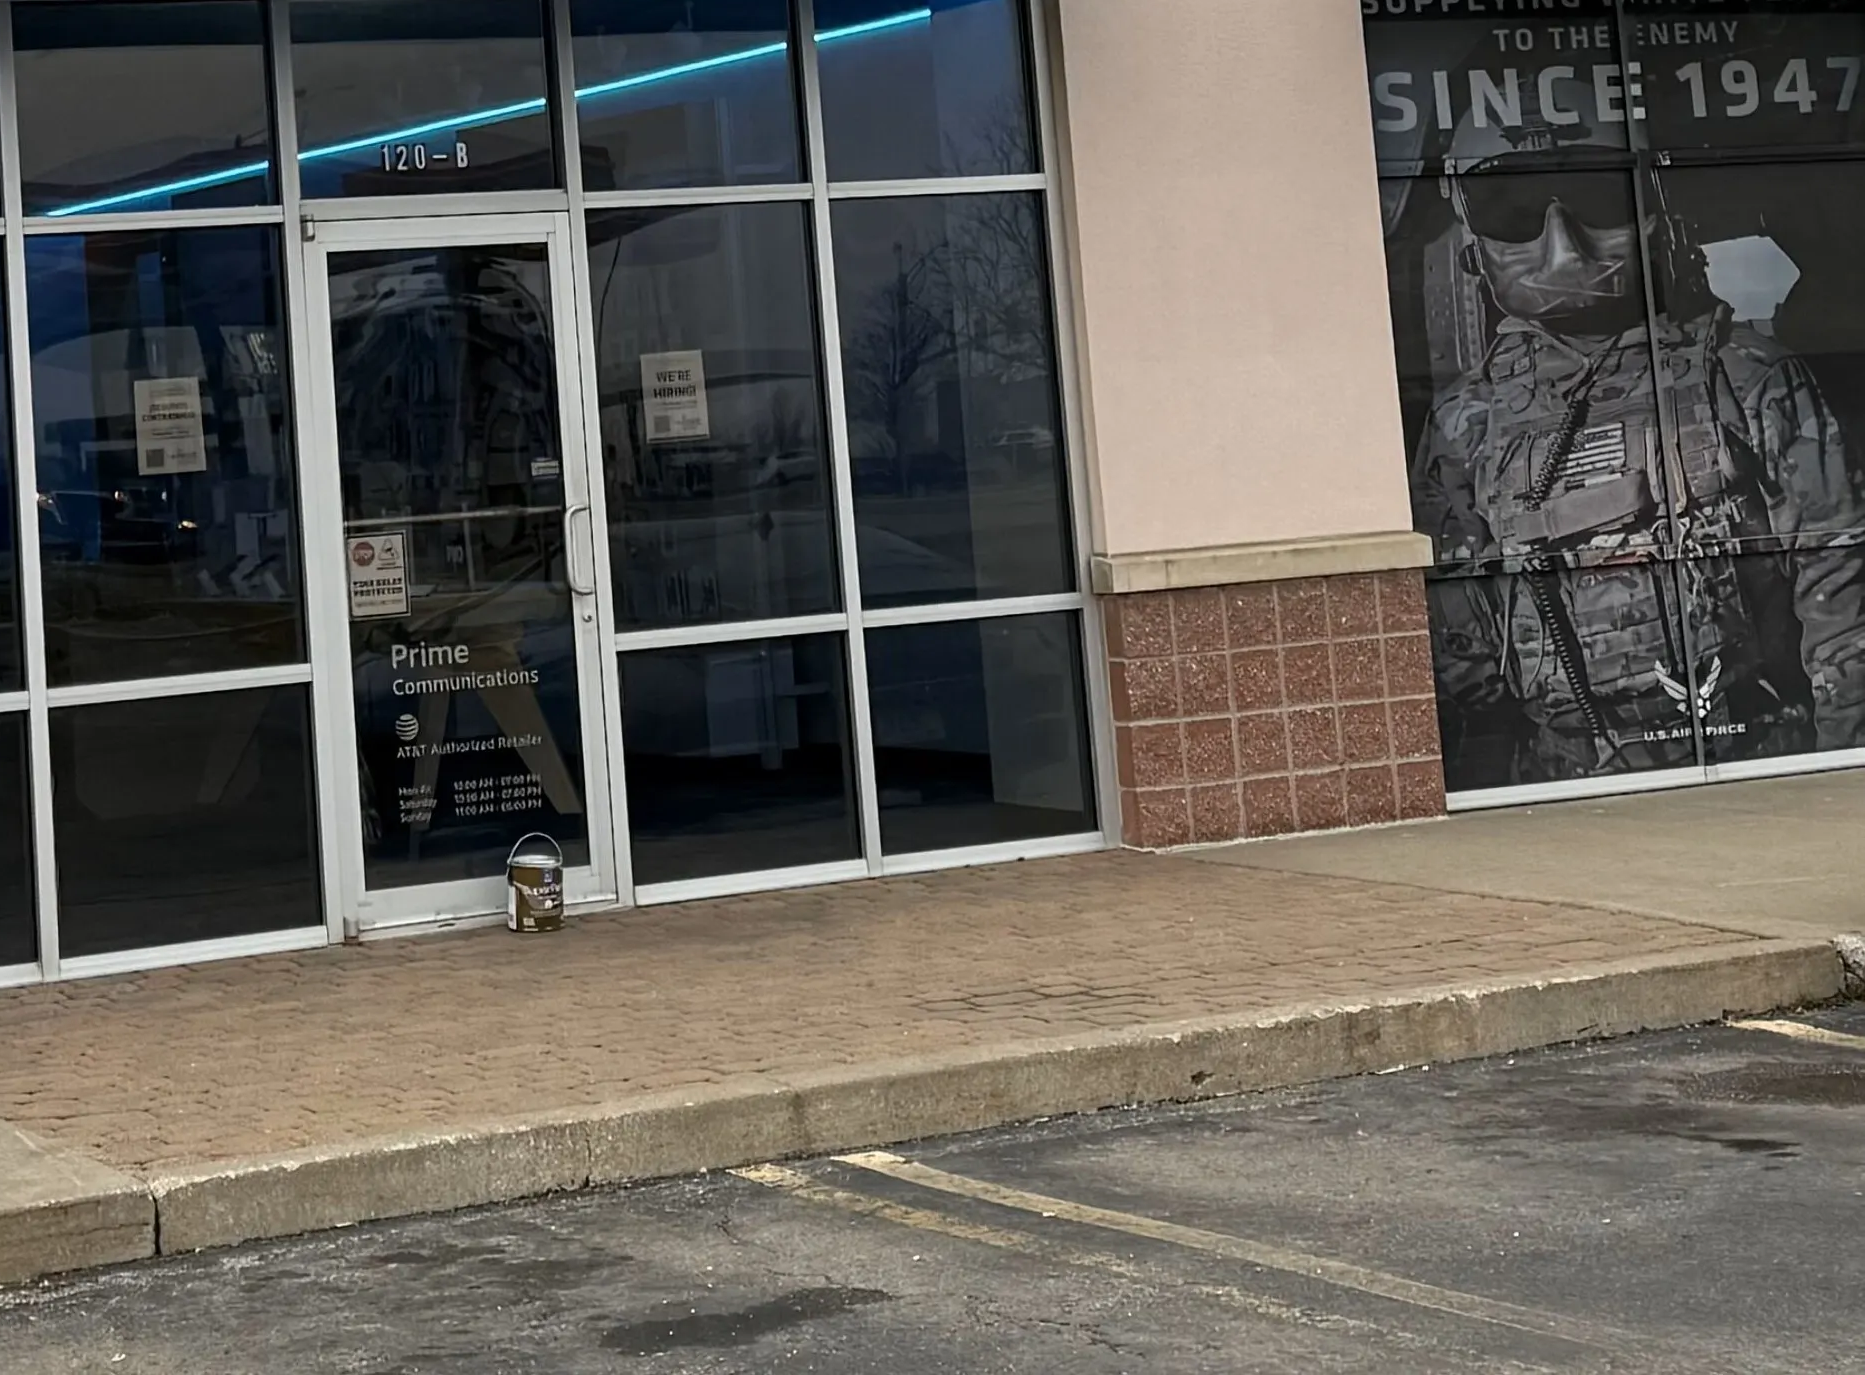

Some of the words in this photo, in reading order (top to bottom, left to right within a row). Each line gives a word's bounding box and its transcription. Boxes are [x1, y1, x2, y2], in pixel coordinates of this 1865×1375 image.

[1493, 28, 1534, 52] TO
[1548, 25, 1610, 49] THE
[1375, 62, 1646, 132] SINCE
[1675, 56, 1862, 118] 1947
[381, 142, 469, 171] 120-B
[391, 643, 470, 669] Prime
[392, 668, 539, 696] Communications
[430, 738, 495, 755] Authorized
[498, 734, 542, 749] Retailer
